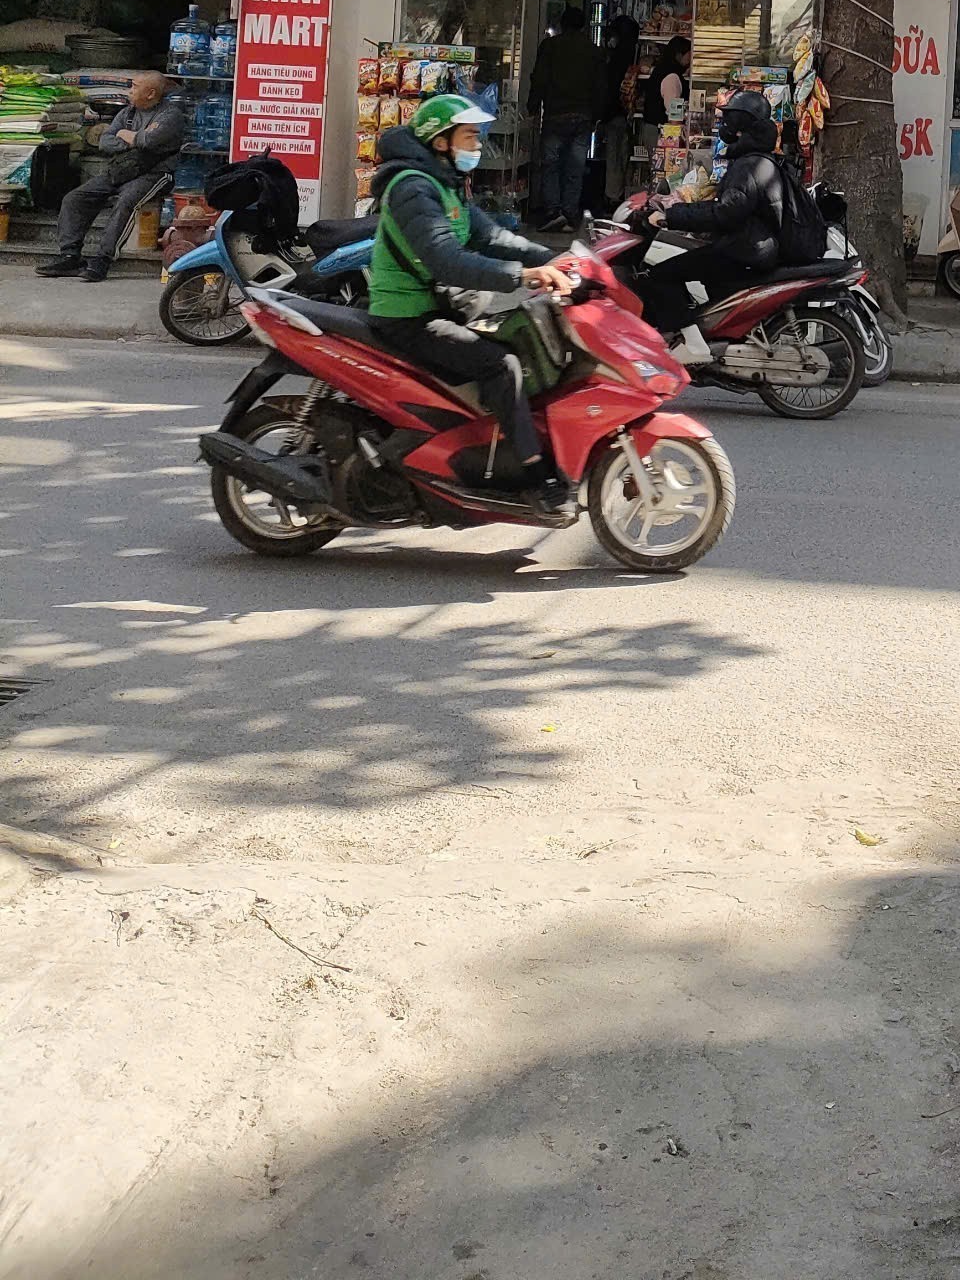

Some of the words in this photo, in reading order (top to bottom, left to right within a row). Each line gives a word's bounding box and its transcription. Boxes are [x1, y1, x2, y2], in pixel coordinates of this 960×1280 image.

[243, 13, 327, 47] MART
[891, 24, 941, 76] SỮA
[250, 67, 272, 77] HÀNG
[262, 84, 283, 95] BÁNH
[284, 87, 300, 98] KẸO
[239, 103, 253, 113] BIA
[251, 121, 272, 132] HÀNG
[895, 117, 934, 160] 5K
